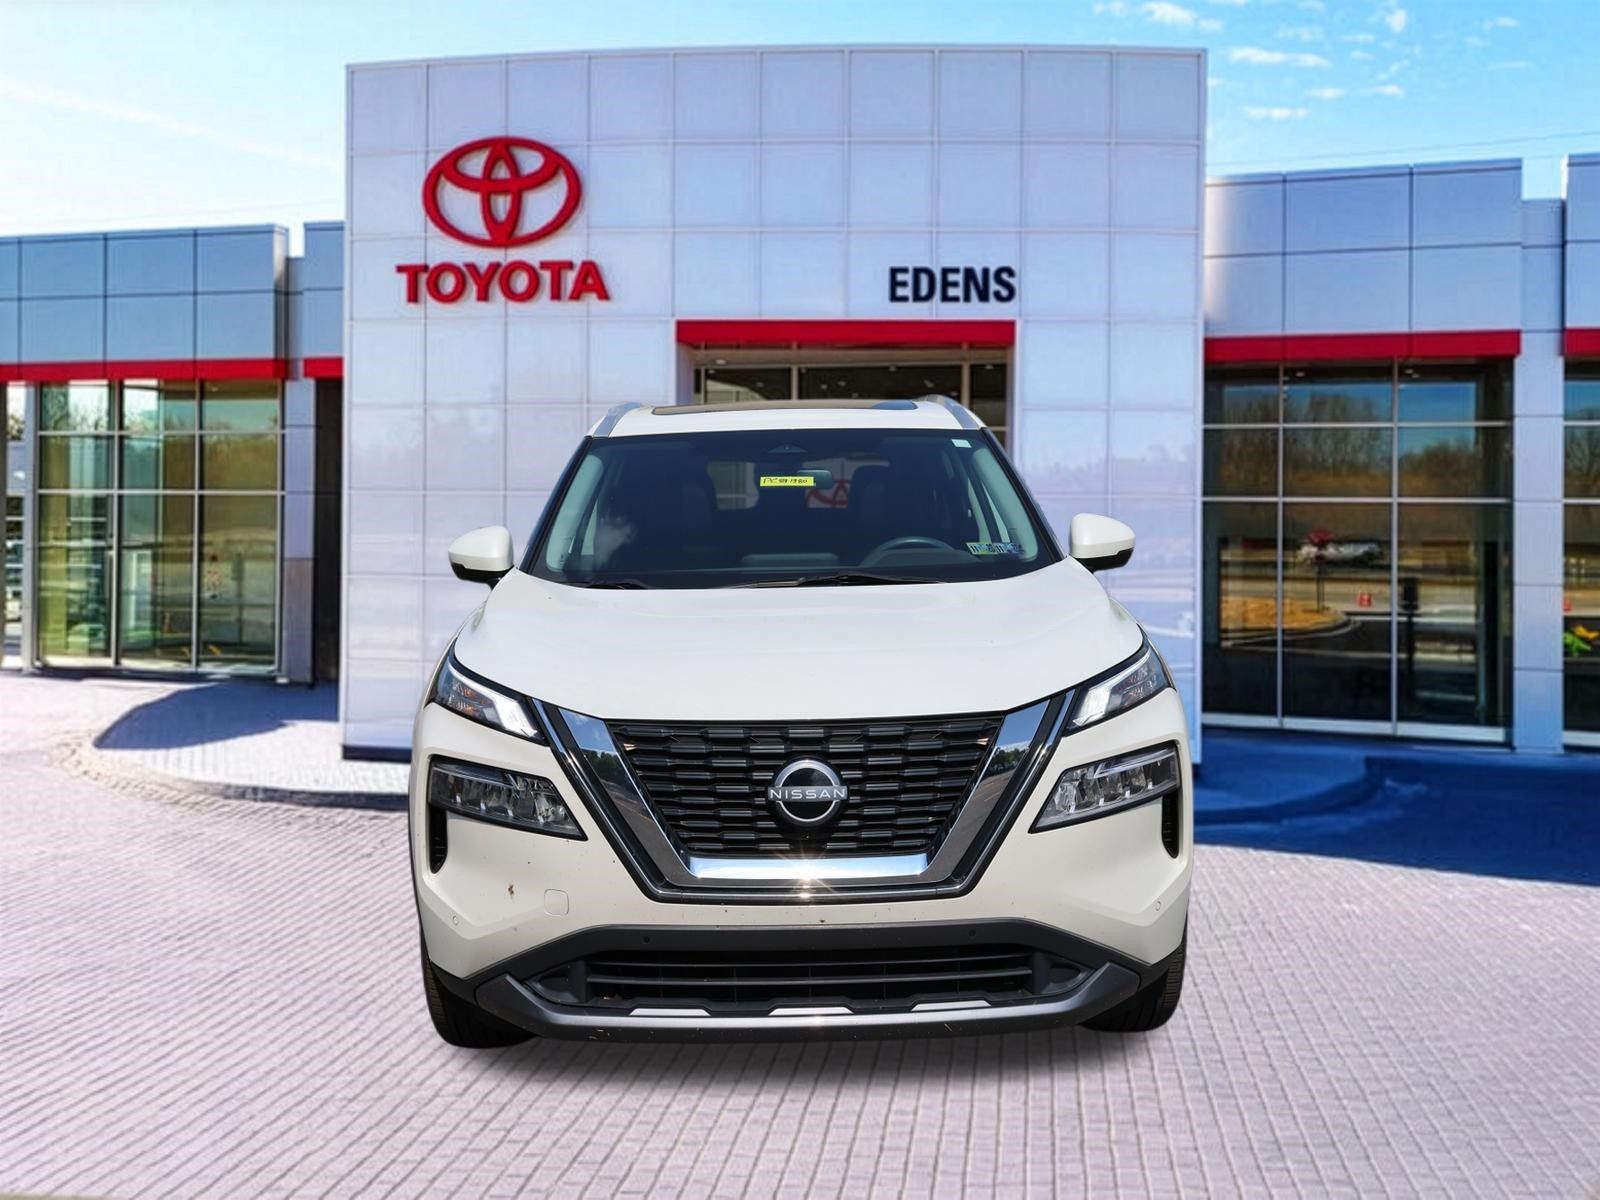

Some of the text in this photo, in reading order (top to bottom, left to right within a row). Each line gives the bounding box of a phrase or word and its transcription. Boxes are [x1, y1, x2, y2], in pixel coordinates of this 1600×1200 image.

[396, 261, 610, 304] TOYOTA
[889, 267, 1016, 303] EDENS
[769, 788, 846, 800] NISSAN
